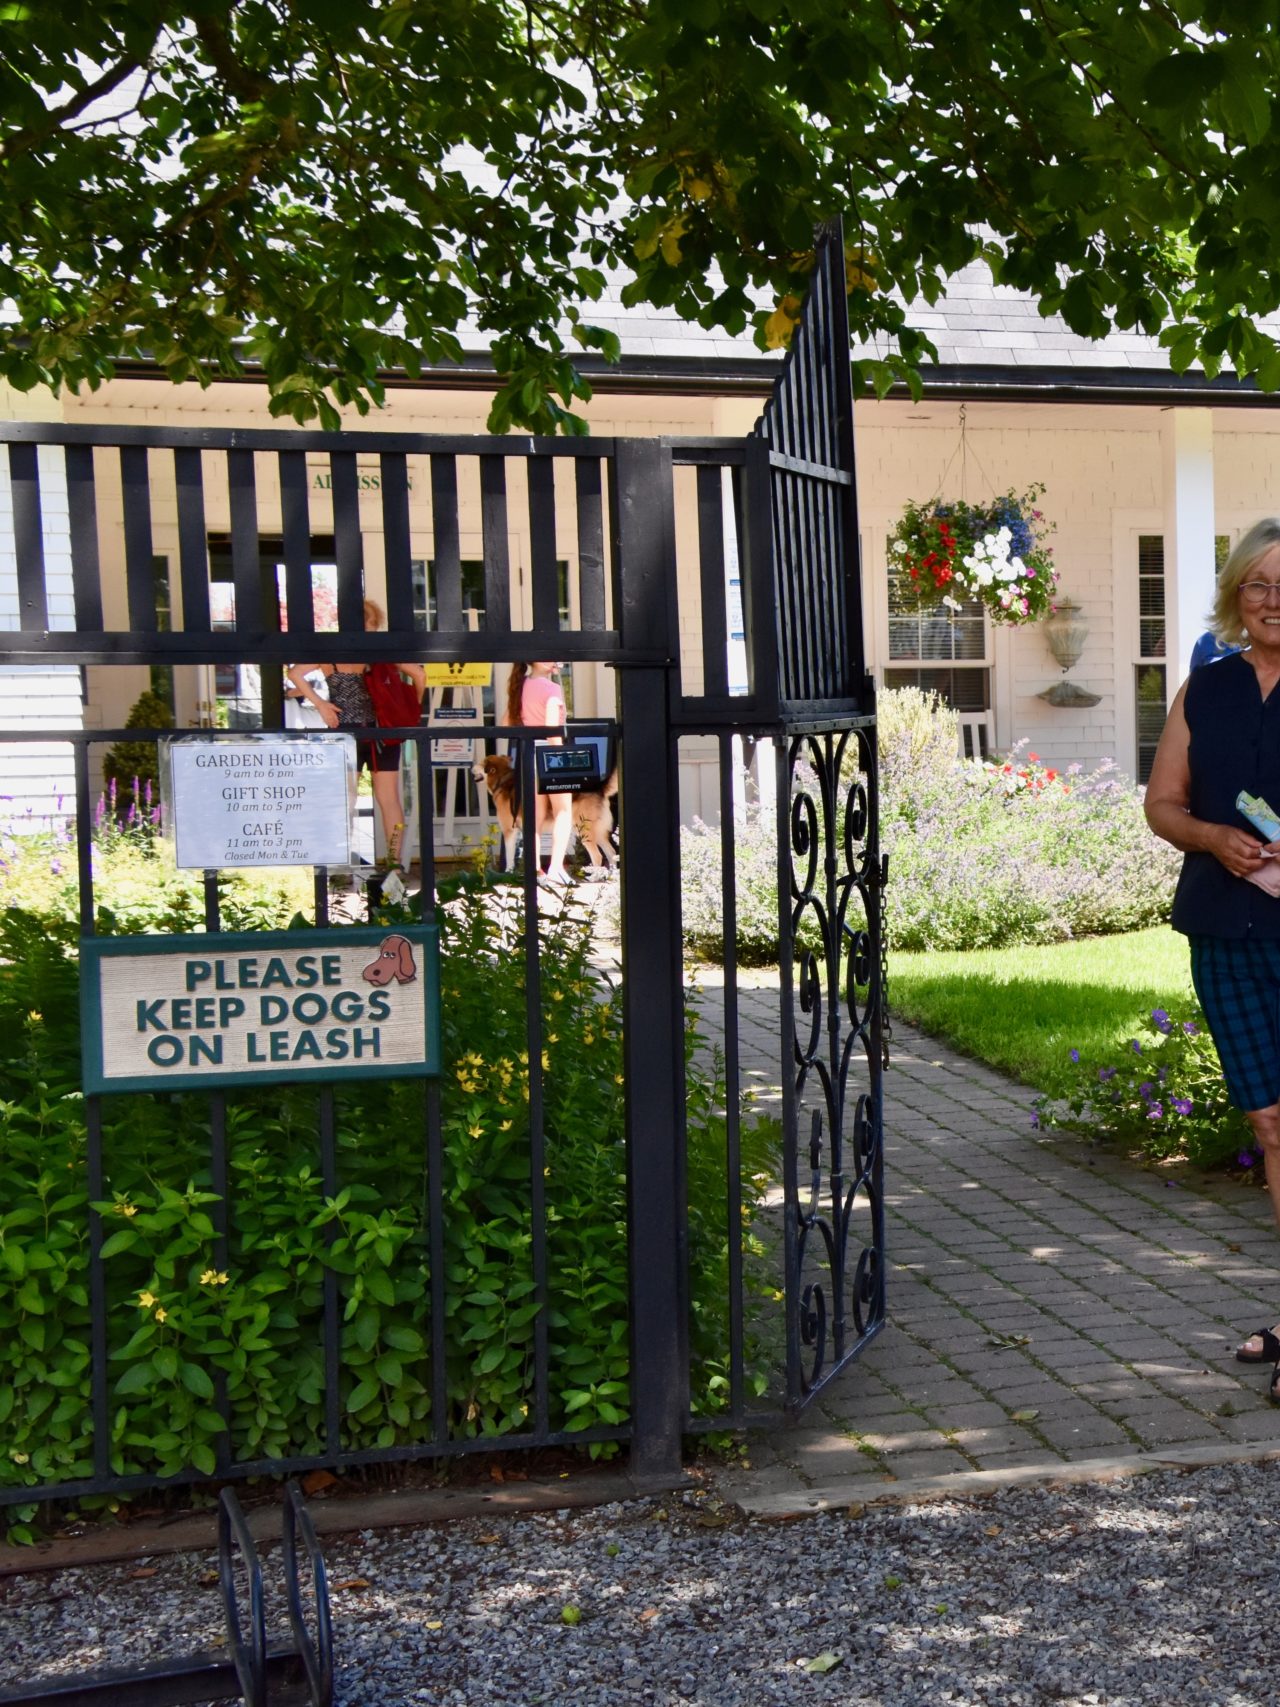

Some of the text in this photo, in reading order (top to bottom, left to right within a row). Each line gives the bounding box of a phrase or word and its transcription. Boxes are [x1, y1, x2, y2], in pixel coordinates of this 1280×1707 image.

[196, 753, 324, 768] GARDEN HOURS
[224, 768, 294, 779] 9 am to 6 pm
[222, 786, 306, 800] GIFT SHOP
[226, 802, 302, 813] 10 am to 5 pm
[242, 820, 284, 836] CAFÉ
[227, 838, 302, 849] 11 am to 3 pm
[224, 850, 309, 861] Closed Mon & Tue
[185, 955, 342, 991] PLEASE
[136, 990, 391, 1032] KEEP DOGS
[147, 1027, 381, 1067] ON LEASH
